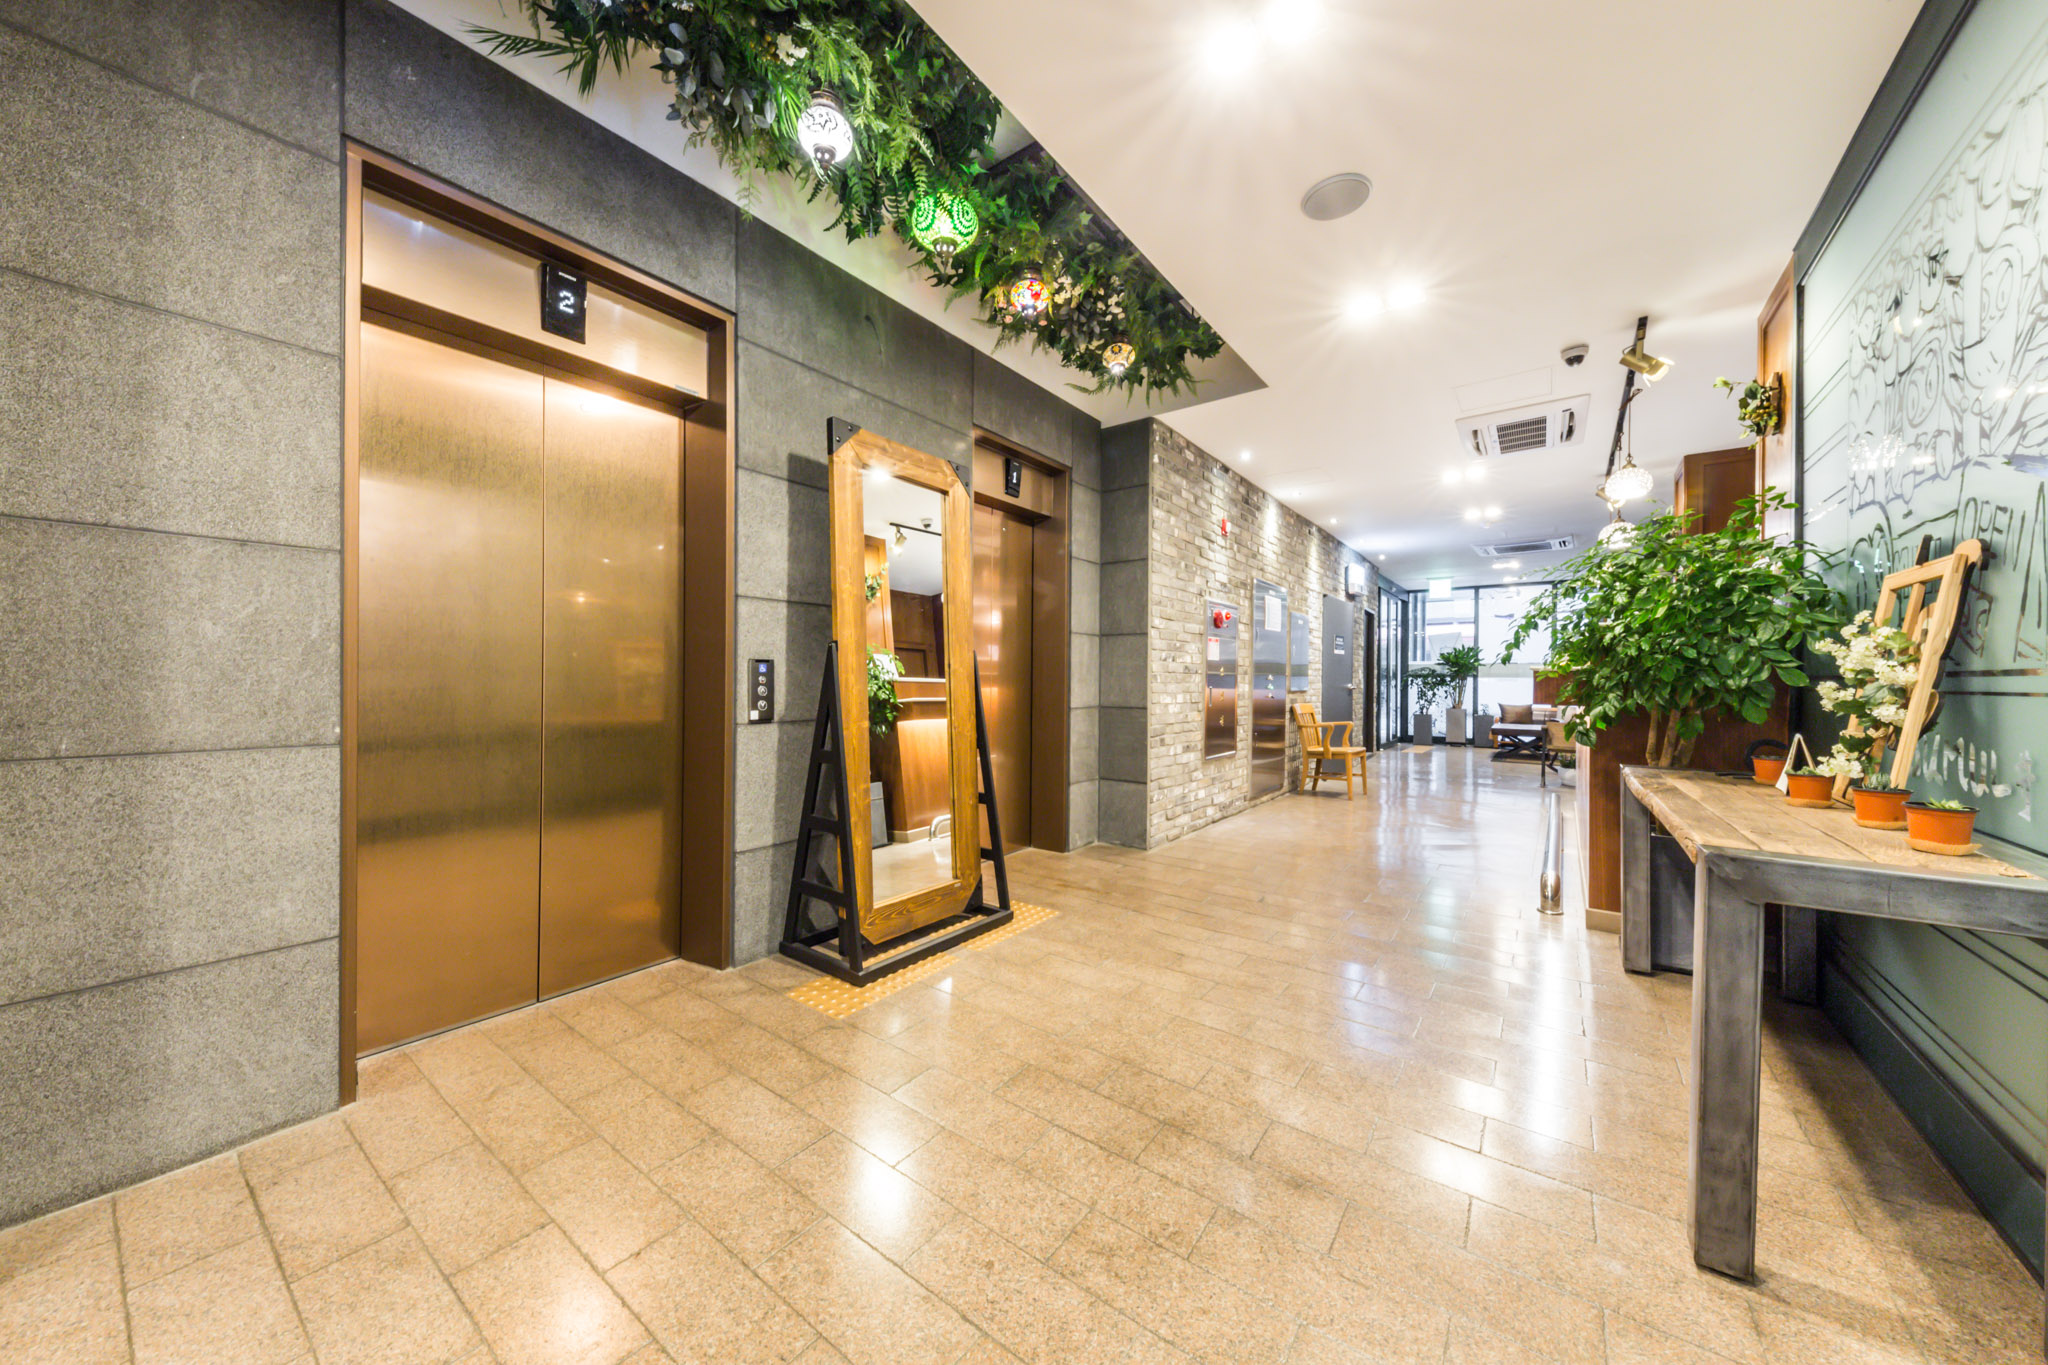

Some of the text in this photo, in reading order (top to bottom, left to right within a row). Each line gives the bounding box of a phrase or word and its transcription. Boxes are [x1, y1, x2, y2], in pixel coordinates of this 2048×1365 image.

[559, 290, 575, 314] 2
[1012, 471, 1017, 484] 1
[1961, 497, 2026, 572] OPEN
